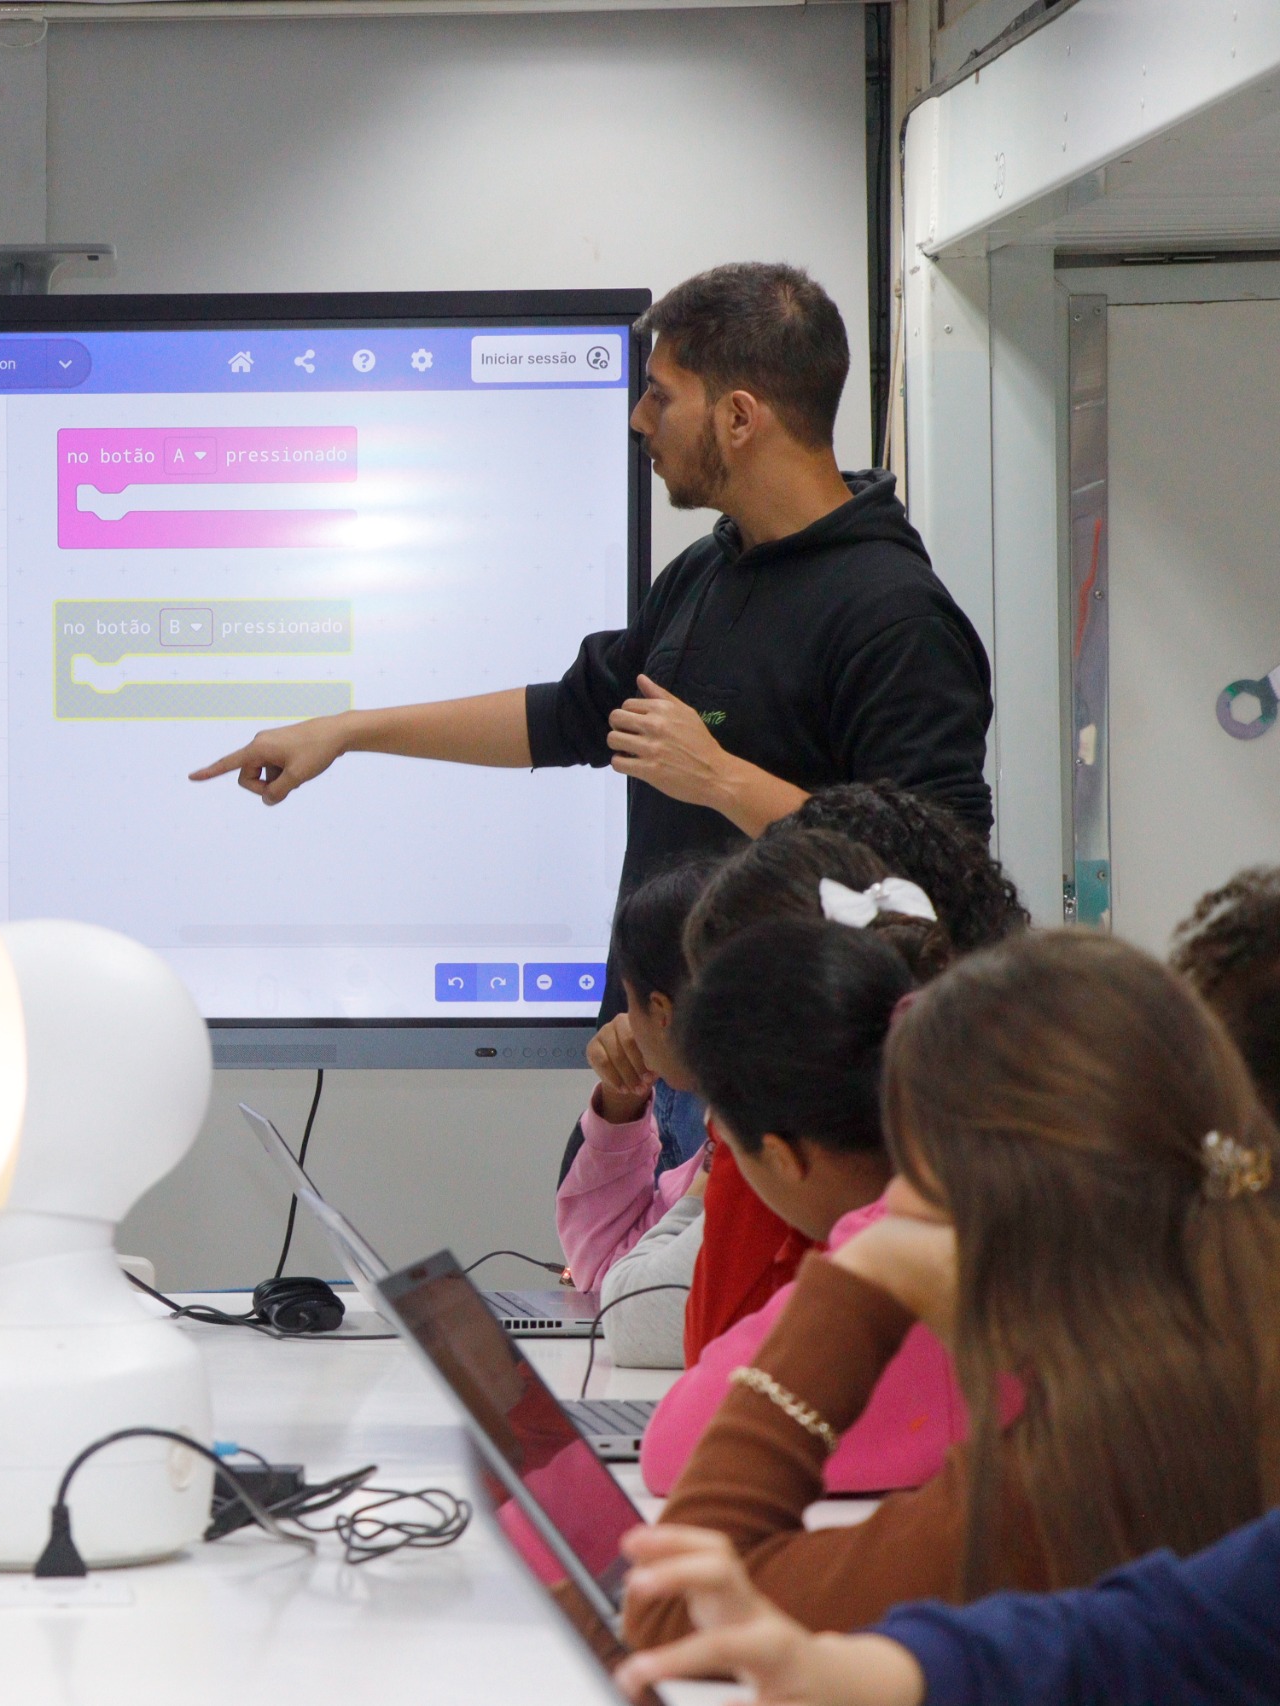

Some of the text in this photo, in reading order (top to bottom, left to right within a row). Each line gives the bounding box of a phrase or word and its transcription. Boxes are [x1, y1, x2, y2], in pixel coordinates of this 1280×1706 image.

[480, 351, 577, 366] Iniciar sessão
[67, 447, 347, 467] no botão A pressionado
[63, 618, 343, 638] no botão B pressionado
